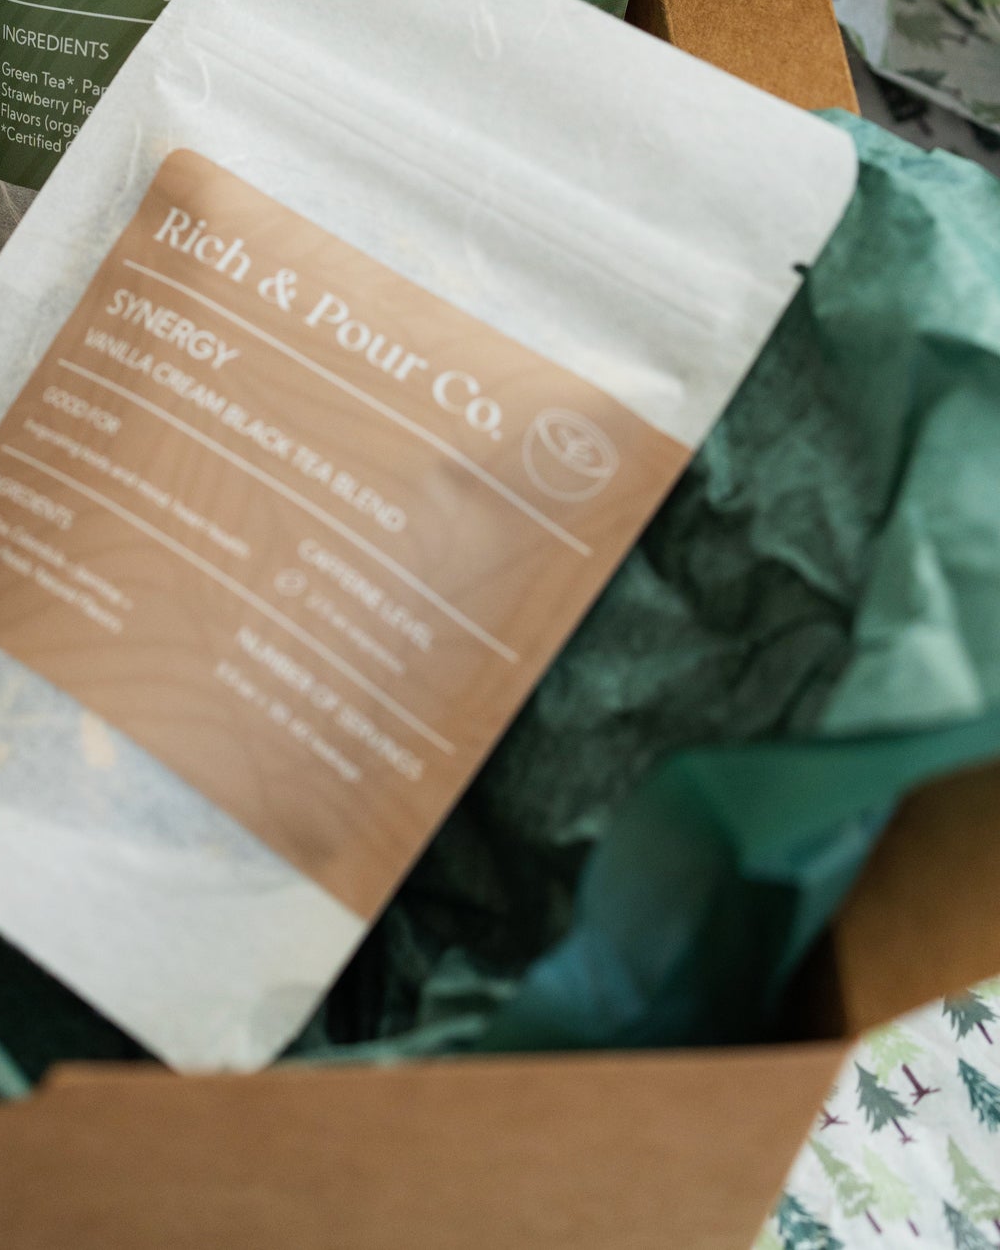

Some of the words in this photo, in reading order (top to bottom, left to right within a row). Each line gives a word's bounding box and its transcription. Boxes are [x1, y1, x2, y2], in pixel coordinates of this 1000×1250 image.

[2, 24, 110, 60] INGREDIENTS
[1, 61, 38, 84] Green
[0, 102, 41, 127] Flavors
[1, 82, 69, 116] Strawberry
[106, 287, 241, 370] SYNERGY
[153, 206, 252, 283] Rich
[257, 267, 298, 312] &
[304, 291, 429, 383] Pour
[432, 370, 502, 443] Co.
[84, 327, 153, 376] VANILLA
[151, 361, 228, 416] CREAM
[221, 403, 294, 459] BLACK
[291, 444, 334, 485] TEA
[330, 469, 407, 533] BLEND
